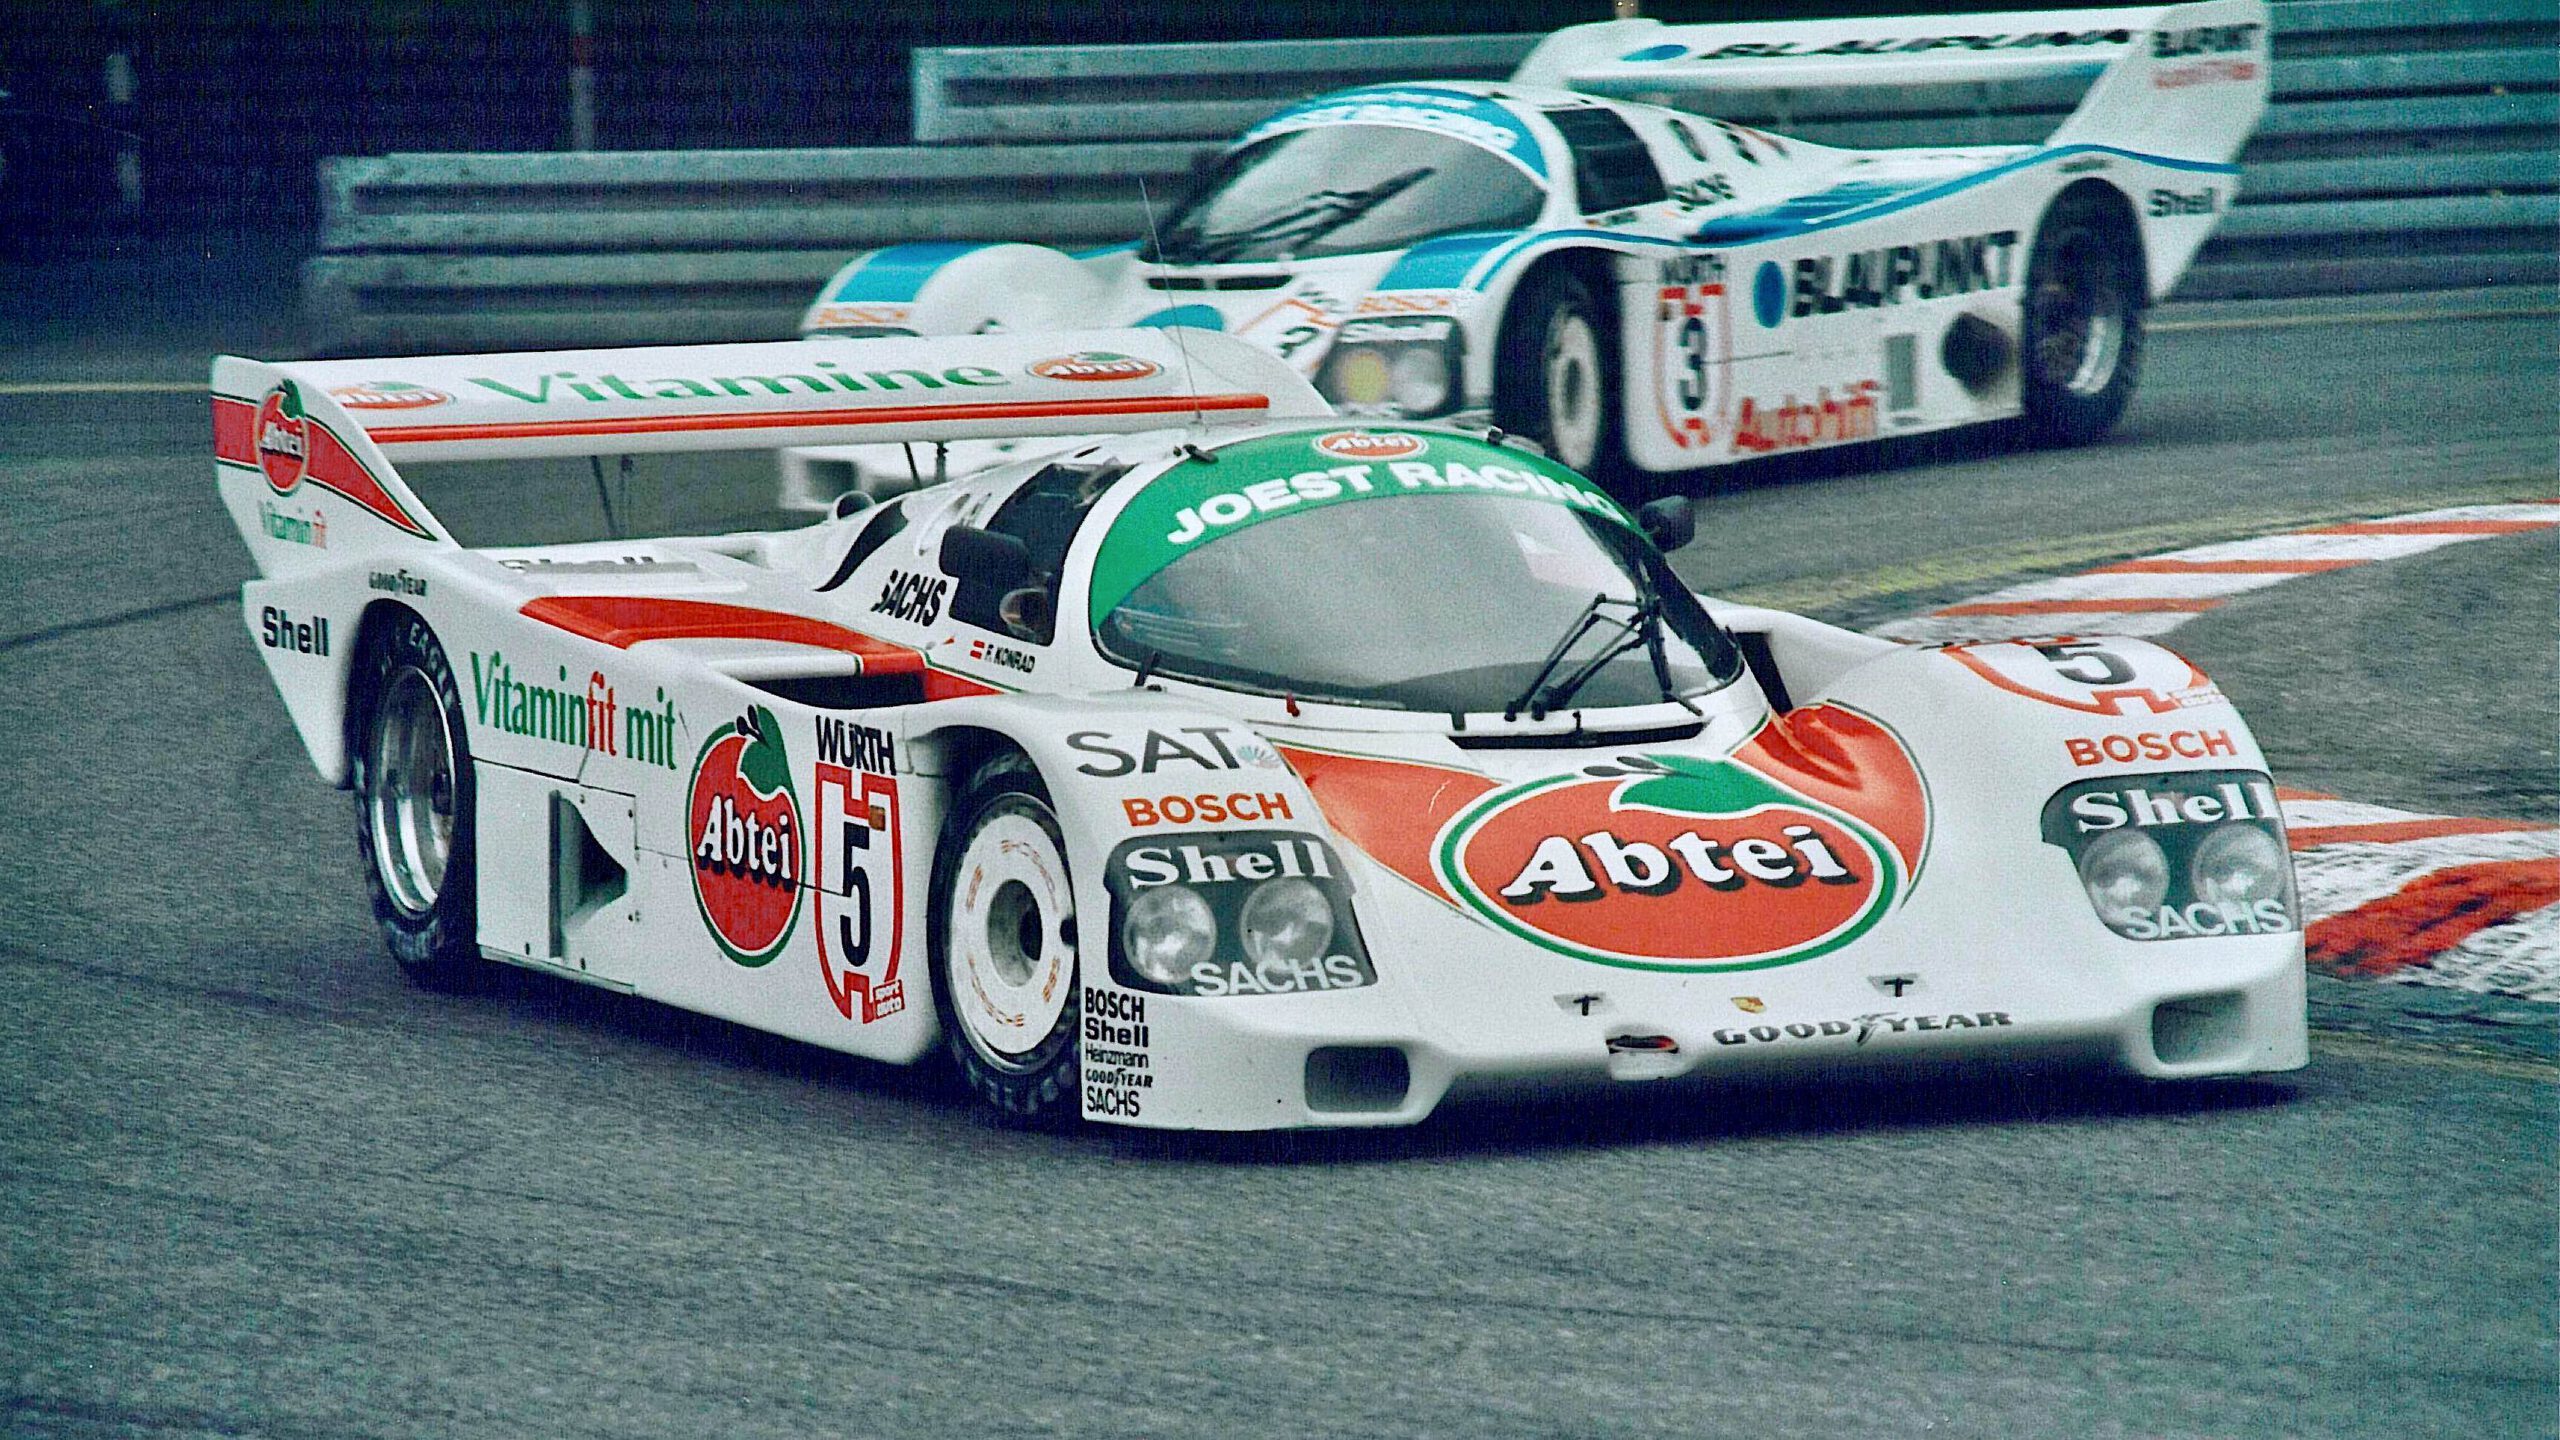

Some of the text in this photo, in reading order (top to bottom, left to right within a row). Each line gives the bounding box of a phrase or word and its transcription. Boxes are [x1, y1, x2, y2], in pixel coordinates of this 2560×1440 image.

[1790, 228, 2022, 318] BLAUPUNKT
[466, 361, 1011, 404] Vitamine
[1045, 355, 1152, 377] Abtei
[1677, 317, 1708, 411] 3
[1327, 431, 1415, 453] Abtei
[1167, 461, 1630, 545] JOEST RACING
[870, 569, 947, 627] SACHS
[262, 606, 331, 657] Shell
[993, 646, 1036, 674] KONRAD
[2032, 642, 2136, 685] 5
[470, 651, 677, 770] Vitaminfit mit
[815, 715, 897, 776] WÜRTH
[1066, 727, 1240, 778] SAT
[2064, 730, 2238, 766] BOSCH
[1122, 792, 1294, 827] BOSCH
[2072, 782, 2280, 833] Shell
[697, 794, 793, 886] Abtei
[1125, 839, 1335, 889] Shell
[1501, 825, 1858, 903] Abtei
[840, 821, 872, 967] 5
[2125, 900, 2293, 940] SACHS
[1189, 954, 1364, 997] SACHS
[1085, 986, 1145, 1023] BOSCH
[1085, 1017, 1149, 1048] Shell
[1712, 1011, 2014, 1046] GOODYEAR
[1086, 1068, 1153, 1088] GOODYEAR
[1087, 1085, 1140, 1117] SACHS
